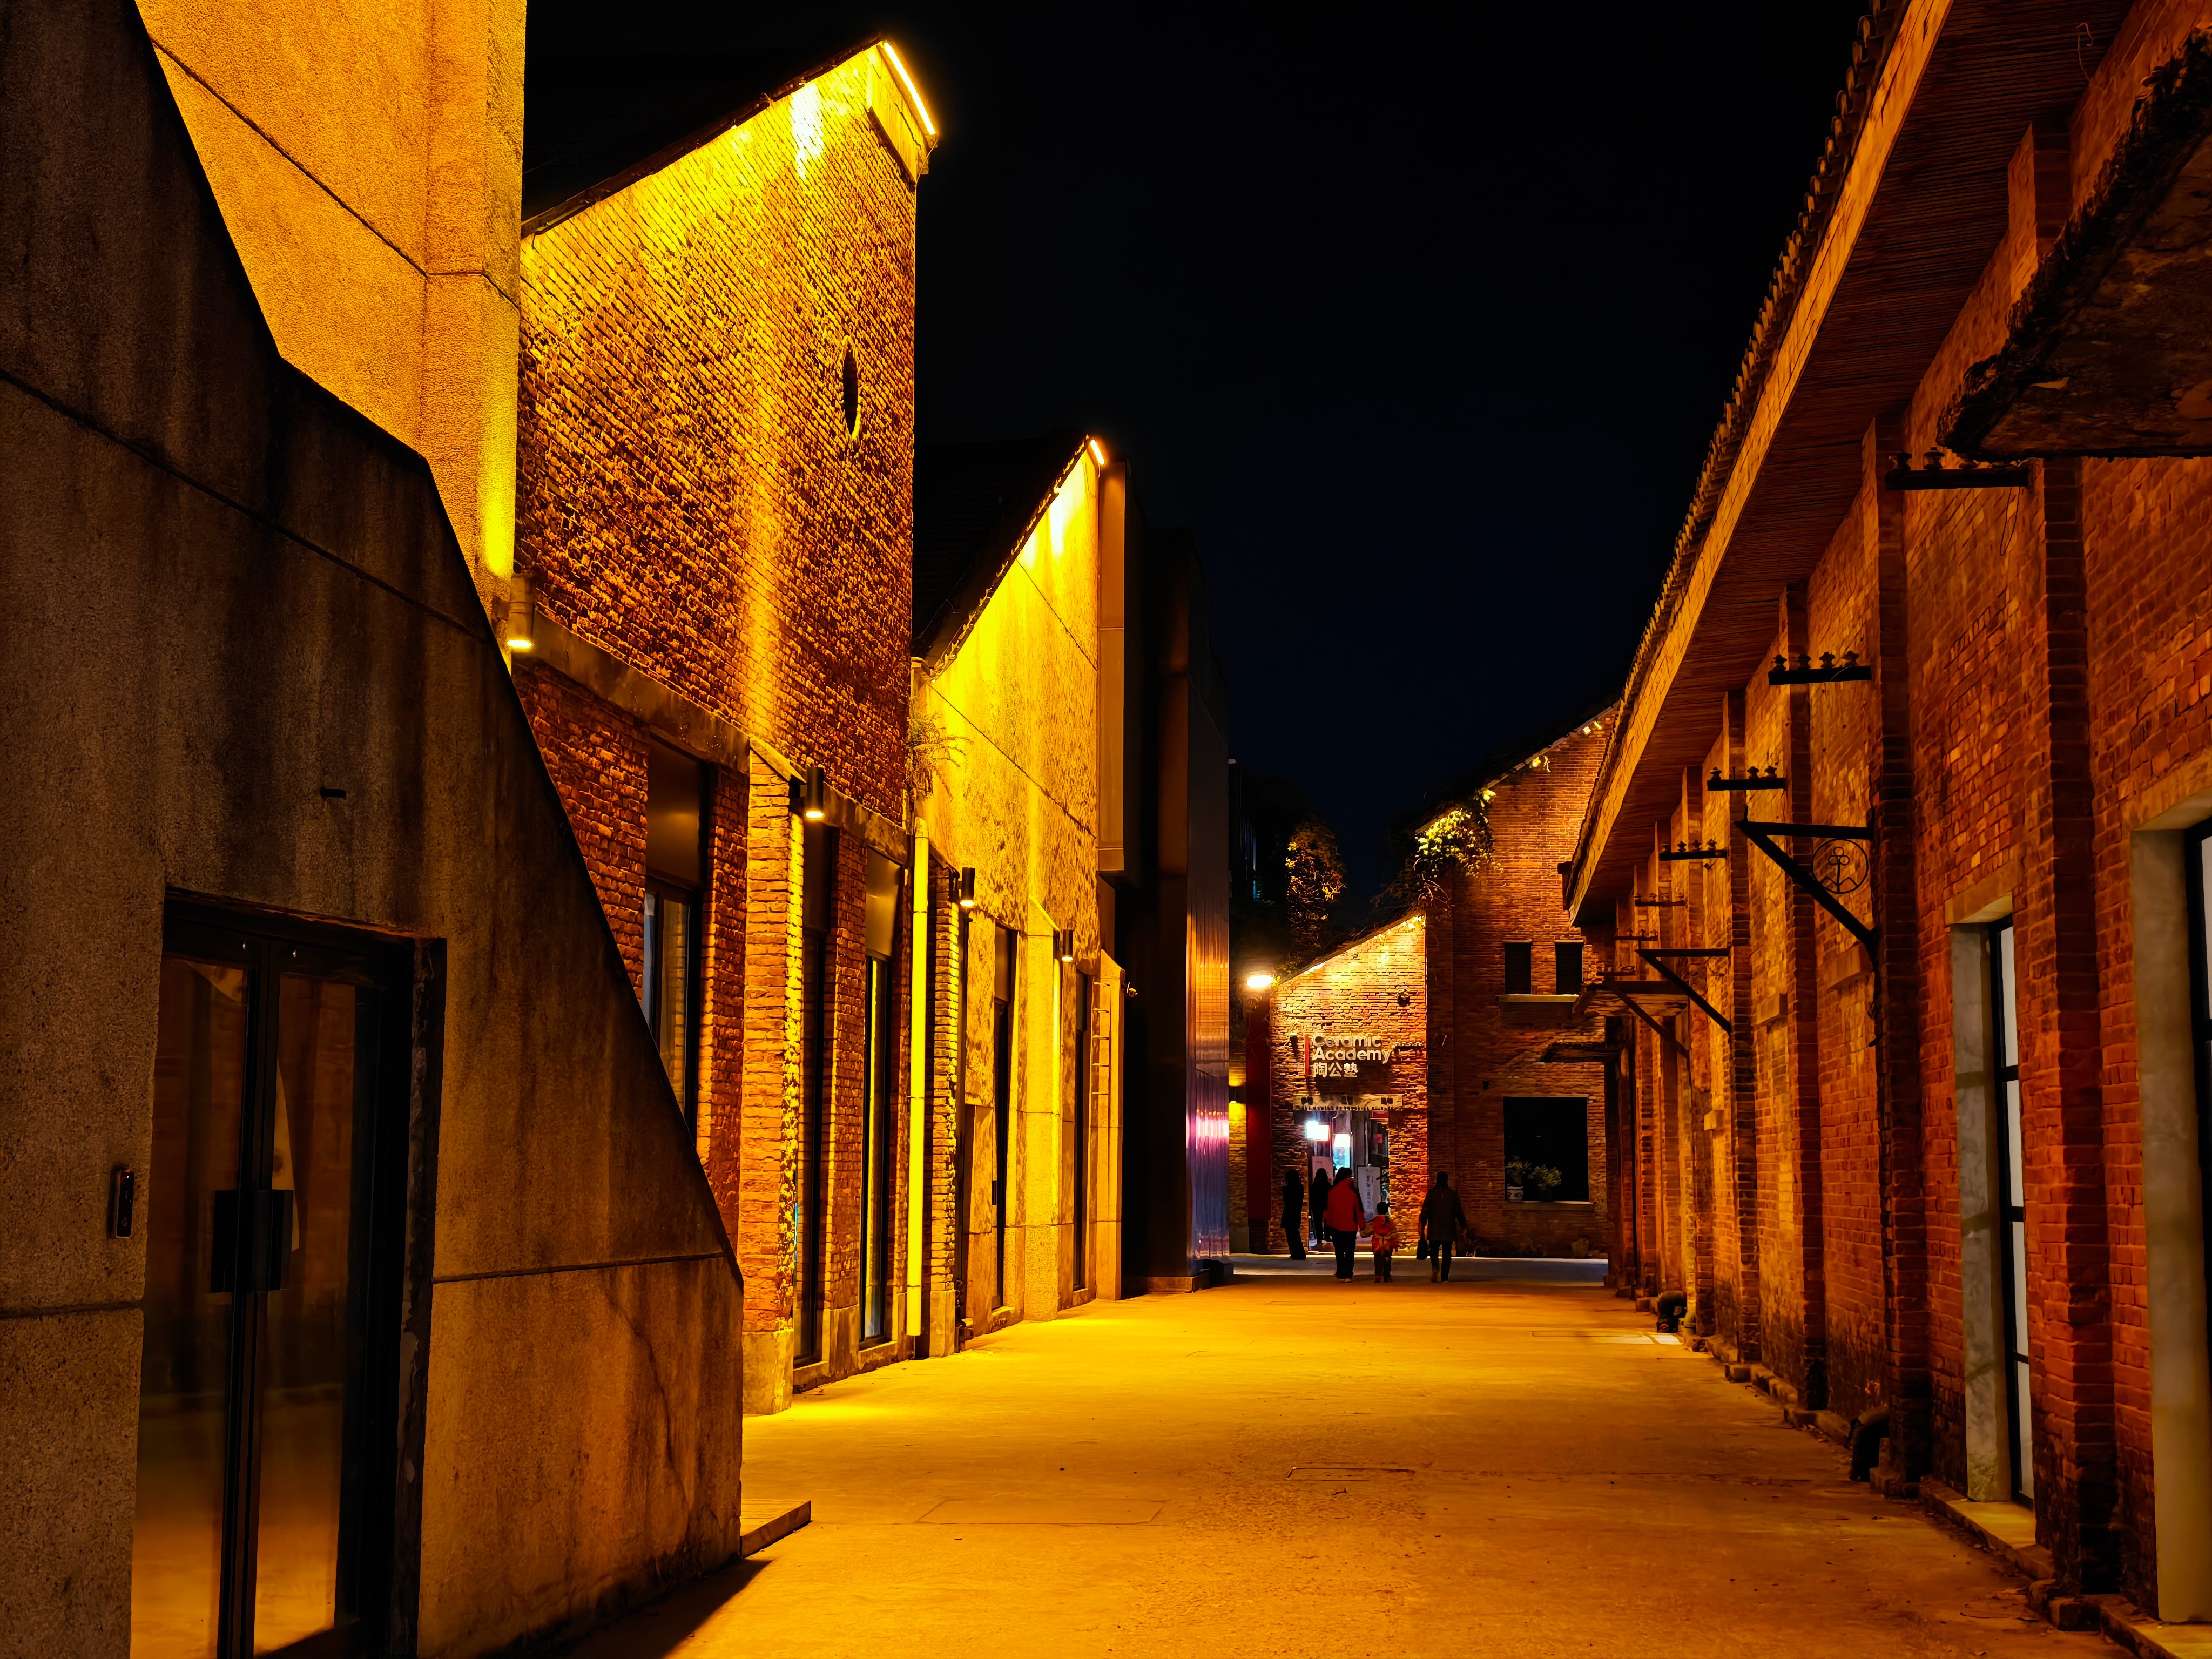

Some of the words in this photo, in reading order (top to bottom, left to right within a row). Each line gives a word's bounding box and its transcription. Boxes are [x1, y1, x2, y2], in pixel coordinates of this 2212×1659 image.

[1312, 1033, 1382, 1047] Ceramic
[1313, 1047, 1392, 1064] Academy
[1313, 1062, 1358, 1077] 陶公塾
